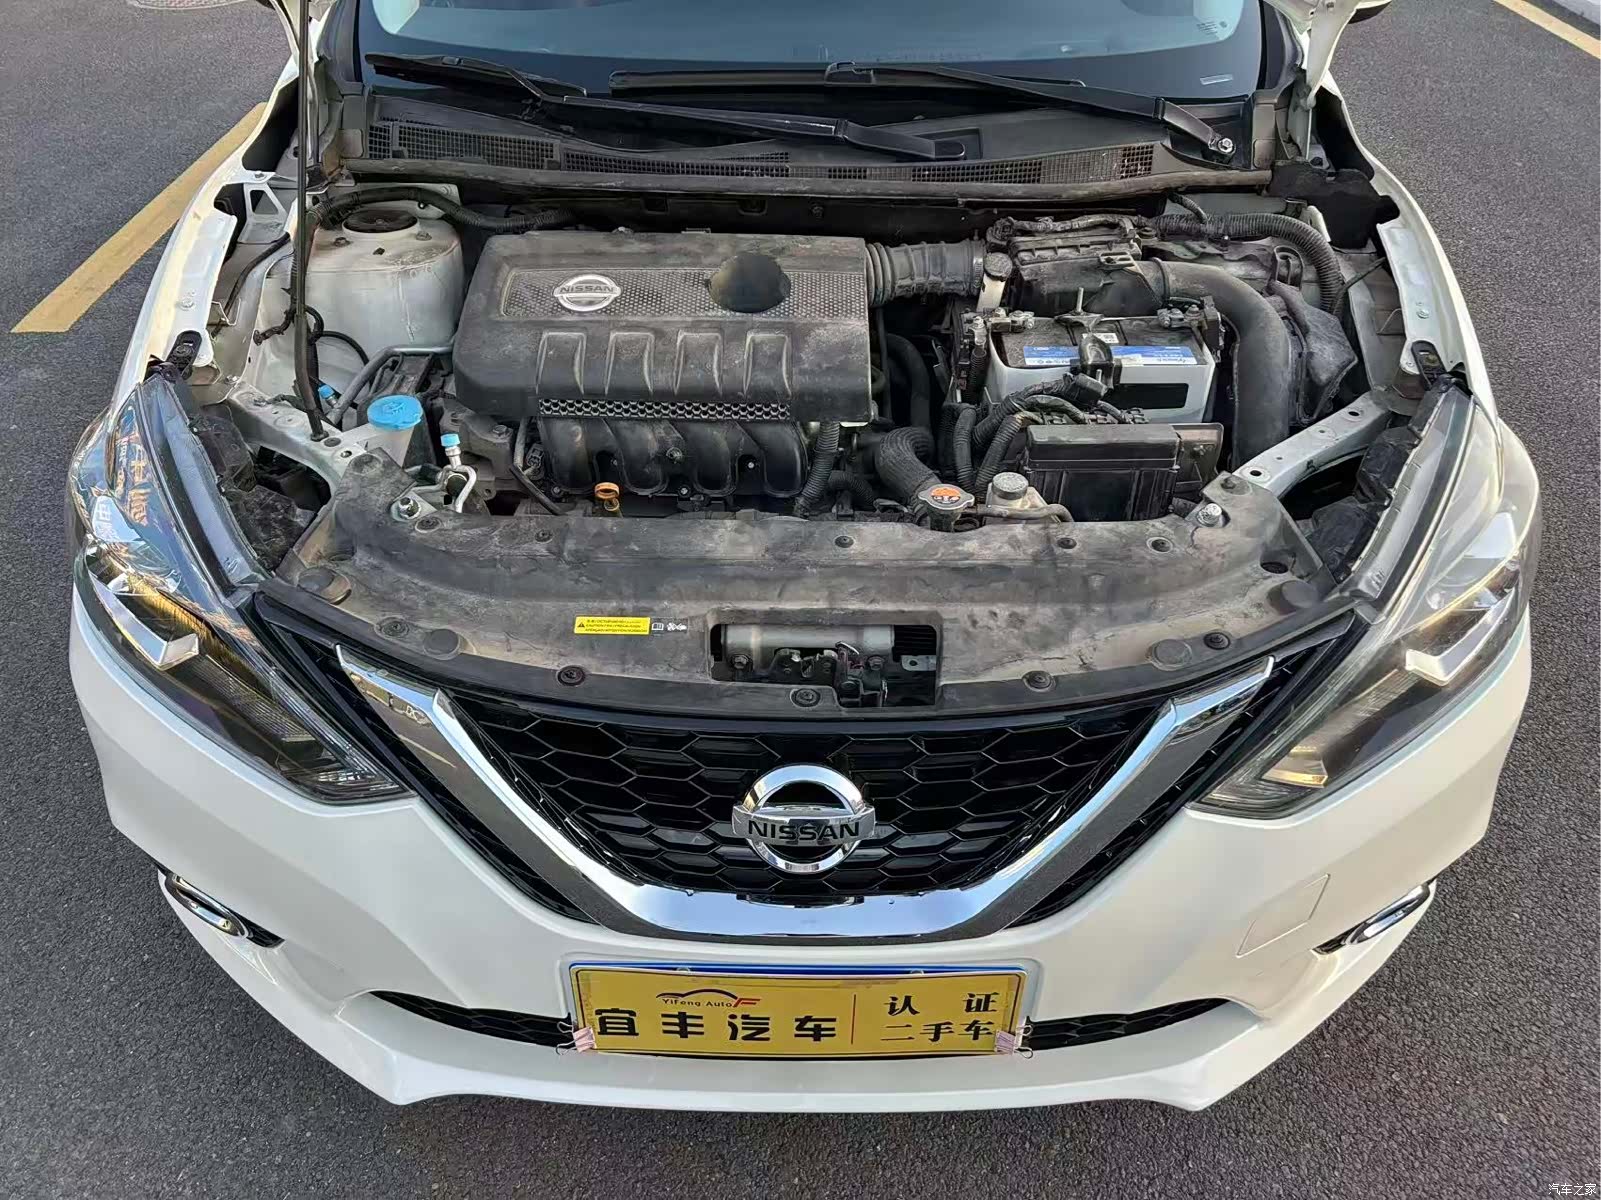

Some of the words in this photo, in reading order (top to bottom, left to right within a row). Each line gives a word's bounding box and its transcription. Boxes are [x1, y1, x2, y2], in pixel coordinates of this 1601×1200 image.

[560, 285, 614, 293] NISSAN
[748, 820, 859, 841] NISSAN
[595, 1007, 837, 1042] 宜丰汽车
[880, 1019, 995, 1042] 二手车
